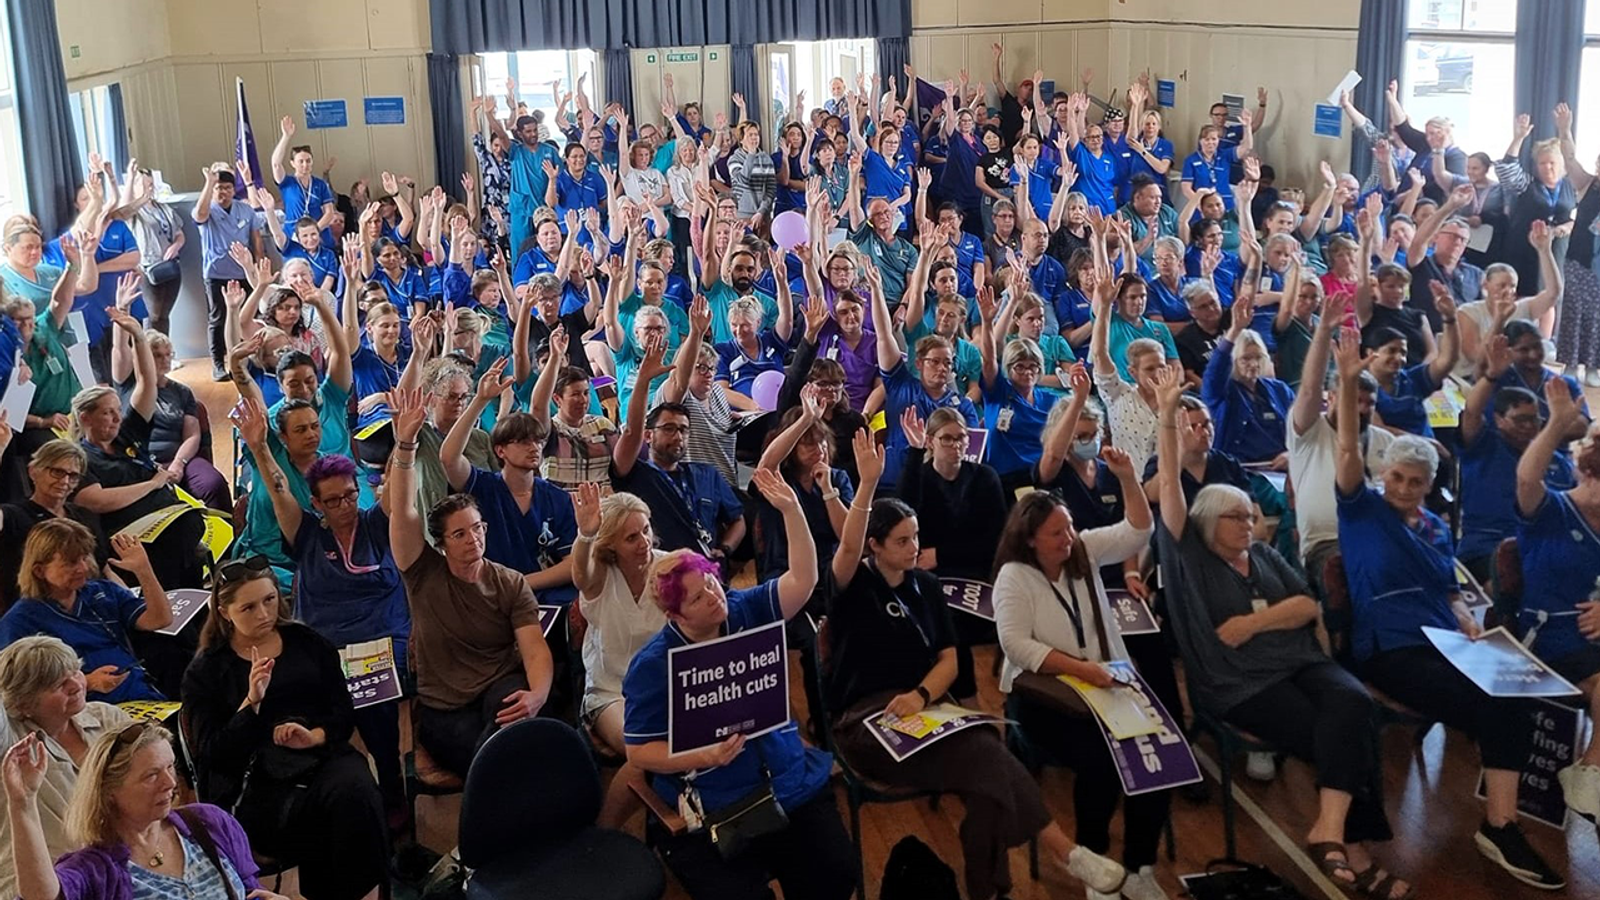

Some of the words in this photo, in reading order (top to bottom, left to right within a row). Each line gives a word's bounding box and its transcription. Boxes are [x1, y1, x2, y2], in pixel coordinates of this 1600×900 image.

[962, 583, 982, 611] TOOT
[1116, 598, 1138, 622] Safe
[678, 666, 724, 688] Time
[728, 660, 746, 676] to
[749, 644, 780, 670] heal
[685, 681, 742, 711] health
[746, 673, 778, 695] cuts
[1534, 711, 1555, 730] fe
